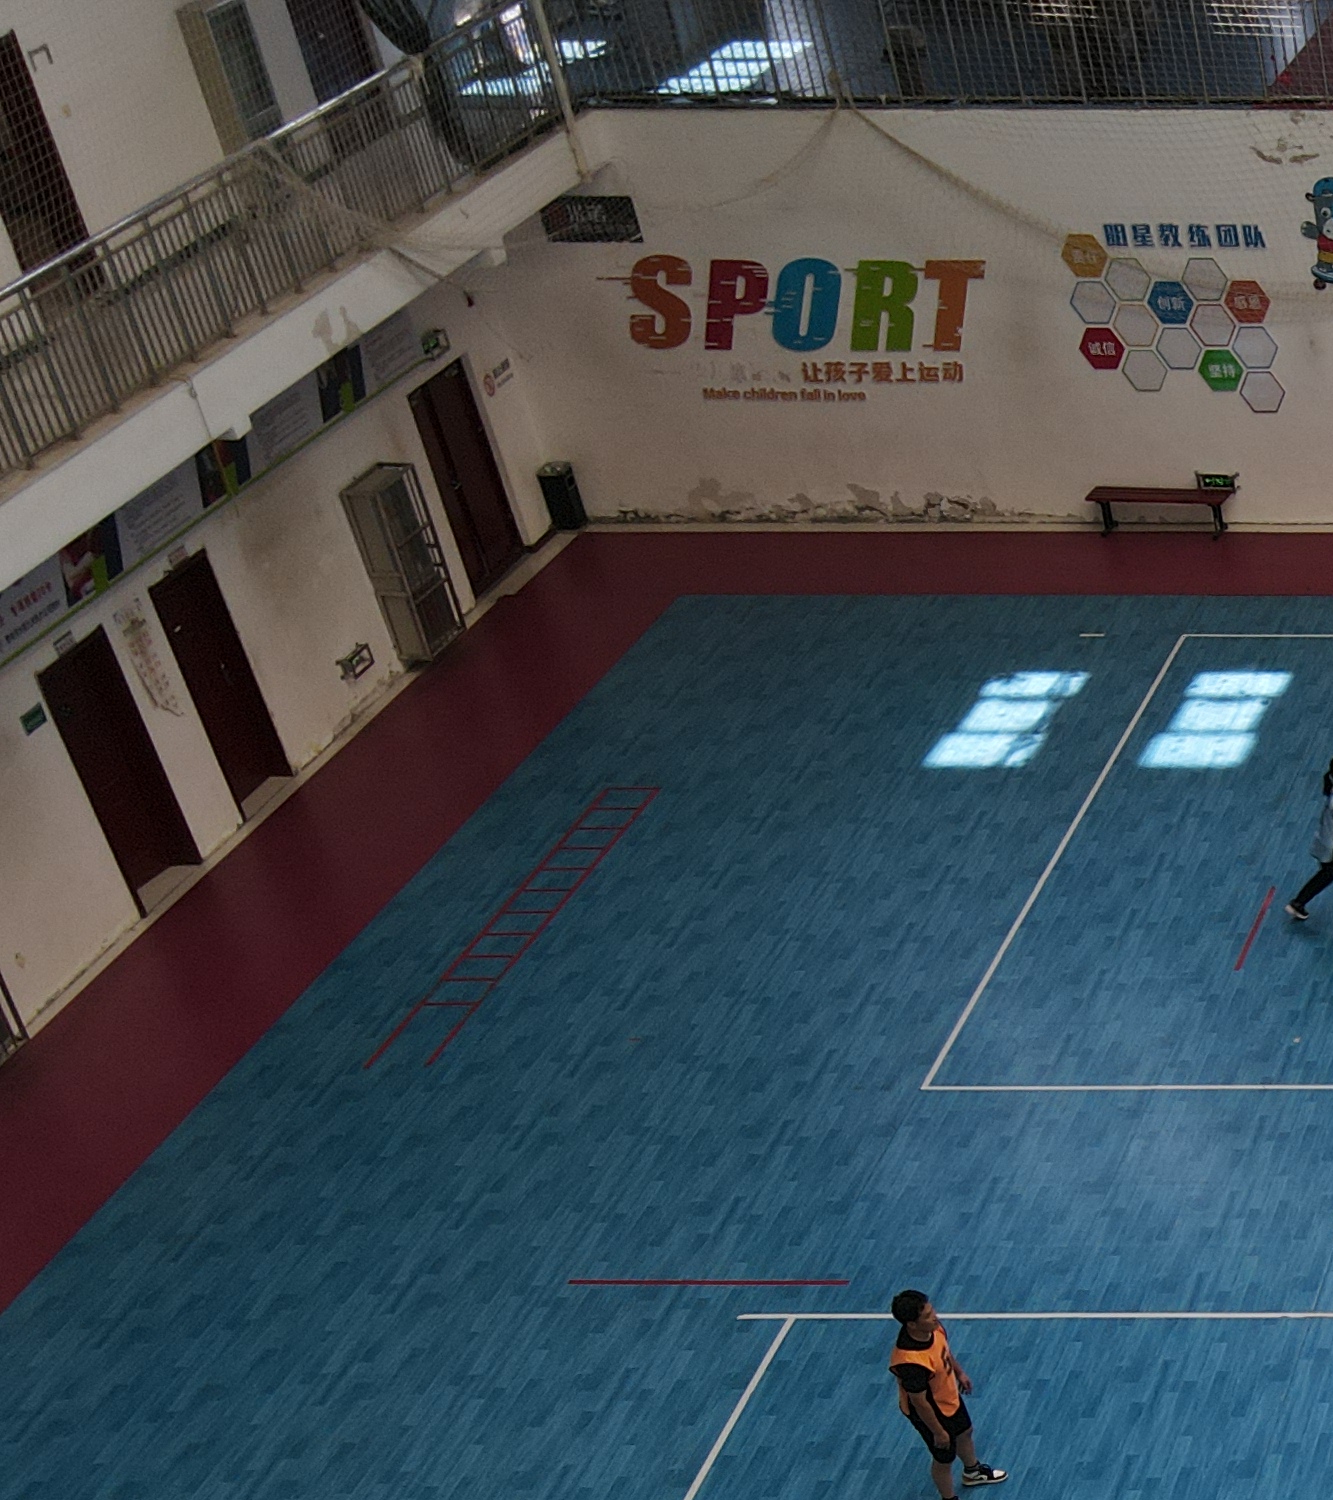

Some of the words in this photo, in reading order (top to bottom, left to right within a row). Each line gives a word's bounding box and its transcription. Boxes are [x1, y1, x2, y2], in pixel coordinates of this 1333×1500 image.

[1104, 223, 1266, 249] 明星教练团队
[629, 254, 986, 351] SPORT
[1088, 342, 1116, 356] 诚信
[801, 361, 963, 384] 让孩子爱上运动
[1208, 364, 1235, 378] 坚持
[702, 387, 740, 400] Make
[743, 387, 797, 400] children
[800, 388, 821, 400] fall
[823, 389, 835, 400] in
[838, 389, 866, 400] love
